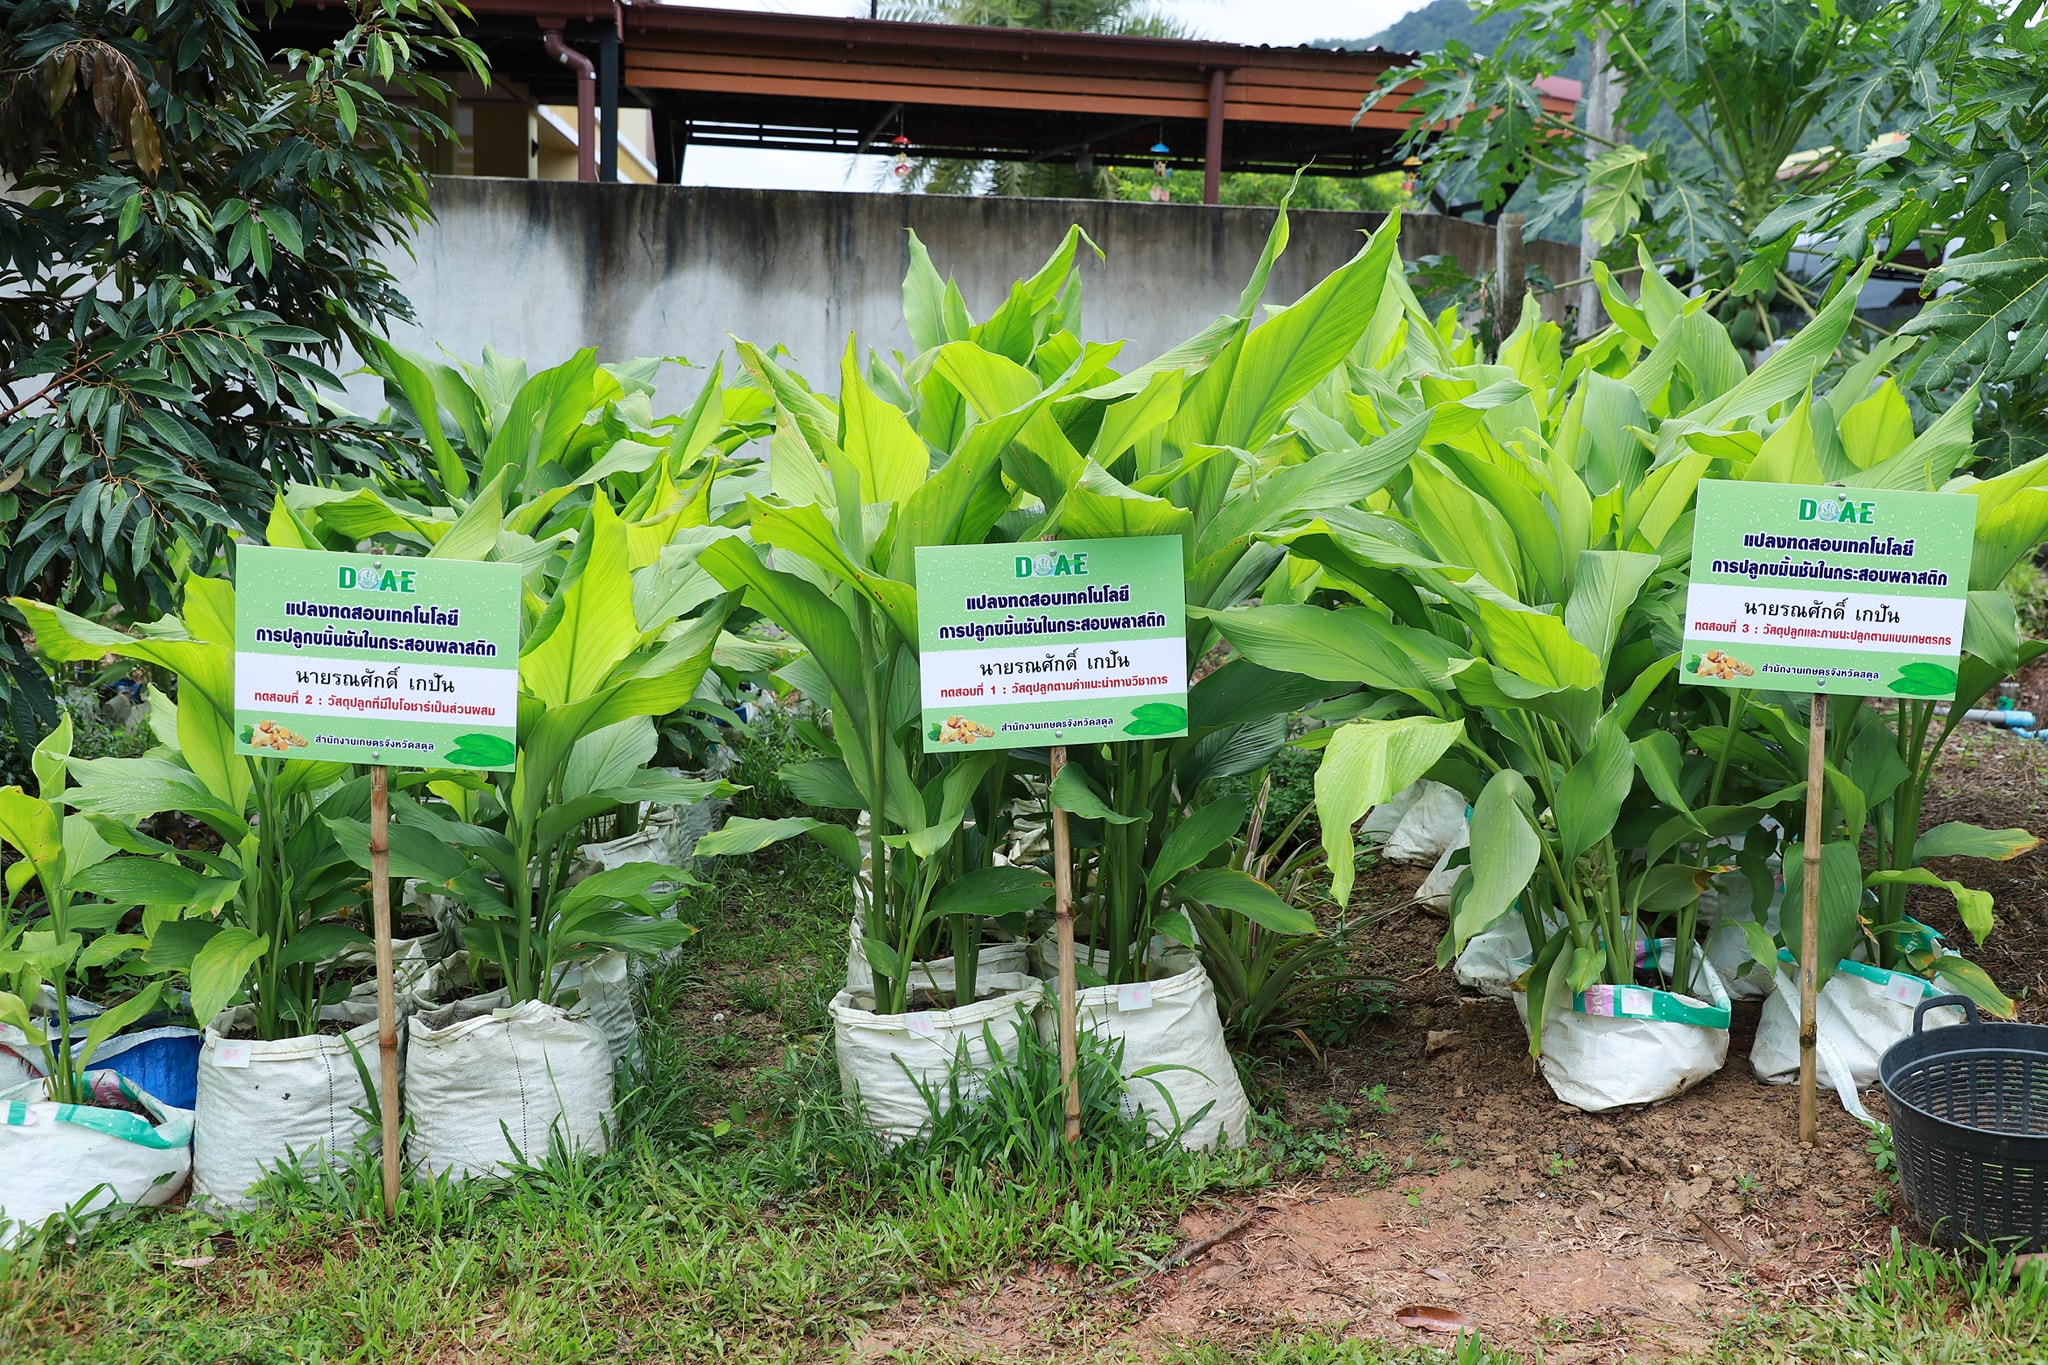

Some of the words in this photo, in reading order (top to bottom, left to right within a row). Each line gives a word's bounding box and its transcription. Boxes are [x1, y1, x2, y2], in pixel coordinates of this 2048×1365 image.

[1744, 533, 1914, 556] แปลงทดสอบเทคโนโลยี
[1712, 557, 1947, 586] การปลูกขมิ้นชันในกระสอบพลาสติก
[966, 584, 1129, 610] แปลงทดสอบเทคโนโลยี
[286, 601, 459, 626] แปลงทดสอบเทคโนโลยี
[1745, 598, 1848, 620] นายรณศักดิ์
[940, 612, 1165, 641] การปลูกขมิ้นชันในกระสอบพลาสติก
[1695, 619, 1736, 633] ทดสอบที่
[1742, 624, 1749, 633] 3
[256, 626, 496, 656] การปลูกขมิ้นชันในกระสอบพลาสติก
[981, 648, 1078, 676] นายรณศักดิ์
[1762, 663, 1879, 680] สำนักงานเกษตรจังหวัดสตูล
[296, 666, 400, 689] นายรณศักดิ์
[255, 690, 299, 704] ทดสอบที่
[305, 695, 312, 704] 2
[940, 683, 984, 698] ทดสอบที่
[991, 686, 995, 694] 1
[1001, 717, 1114, 731] สำนักงานเกษตรจังหวัดสตูล
[315, 735, 434, 751] สำนักงานเกษตรจังหวัดสตูล
